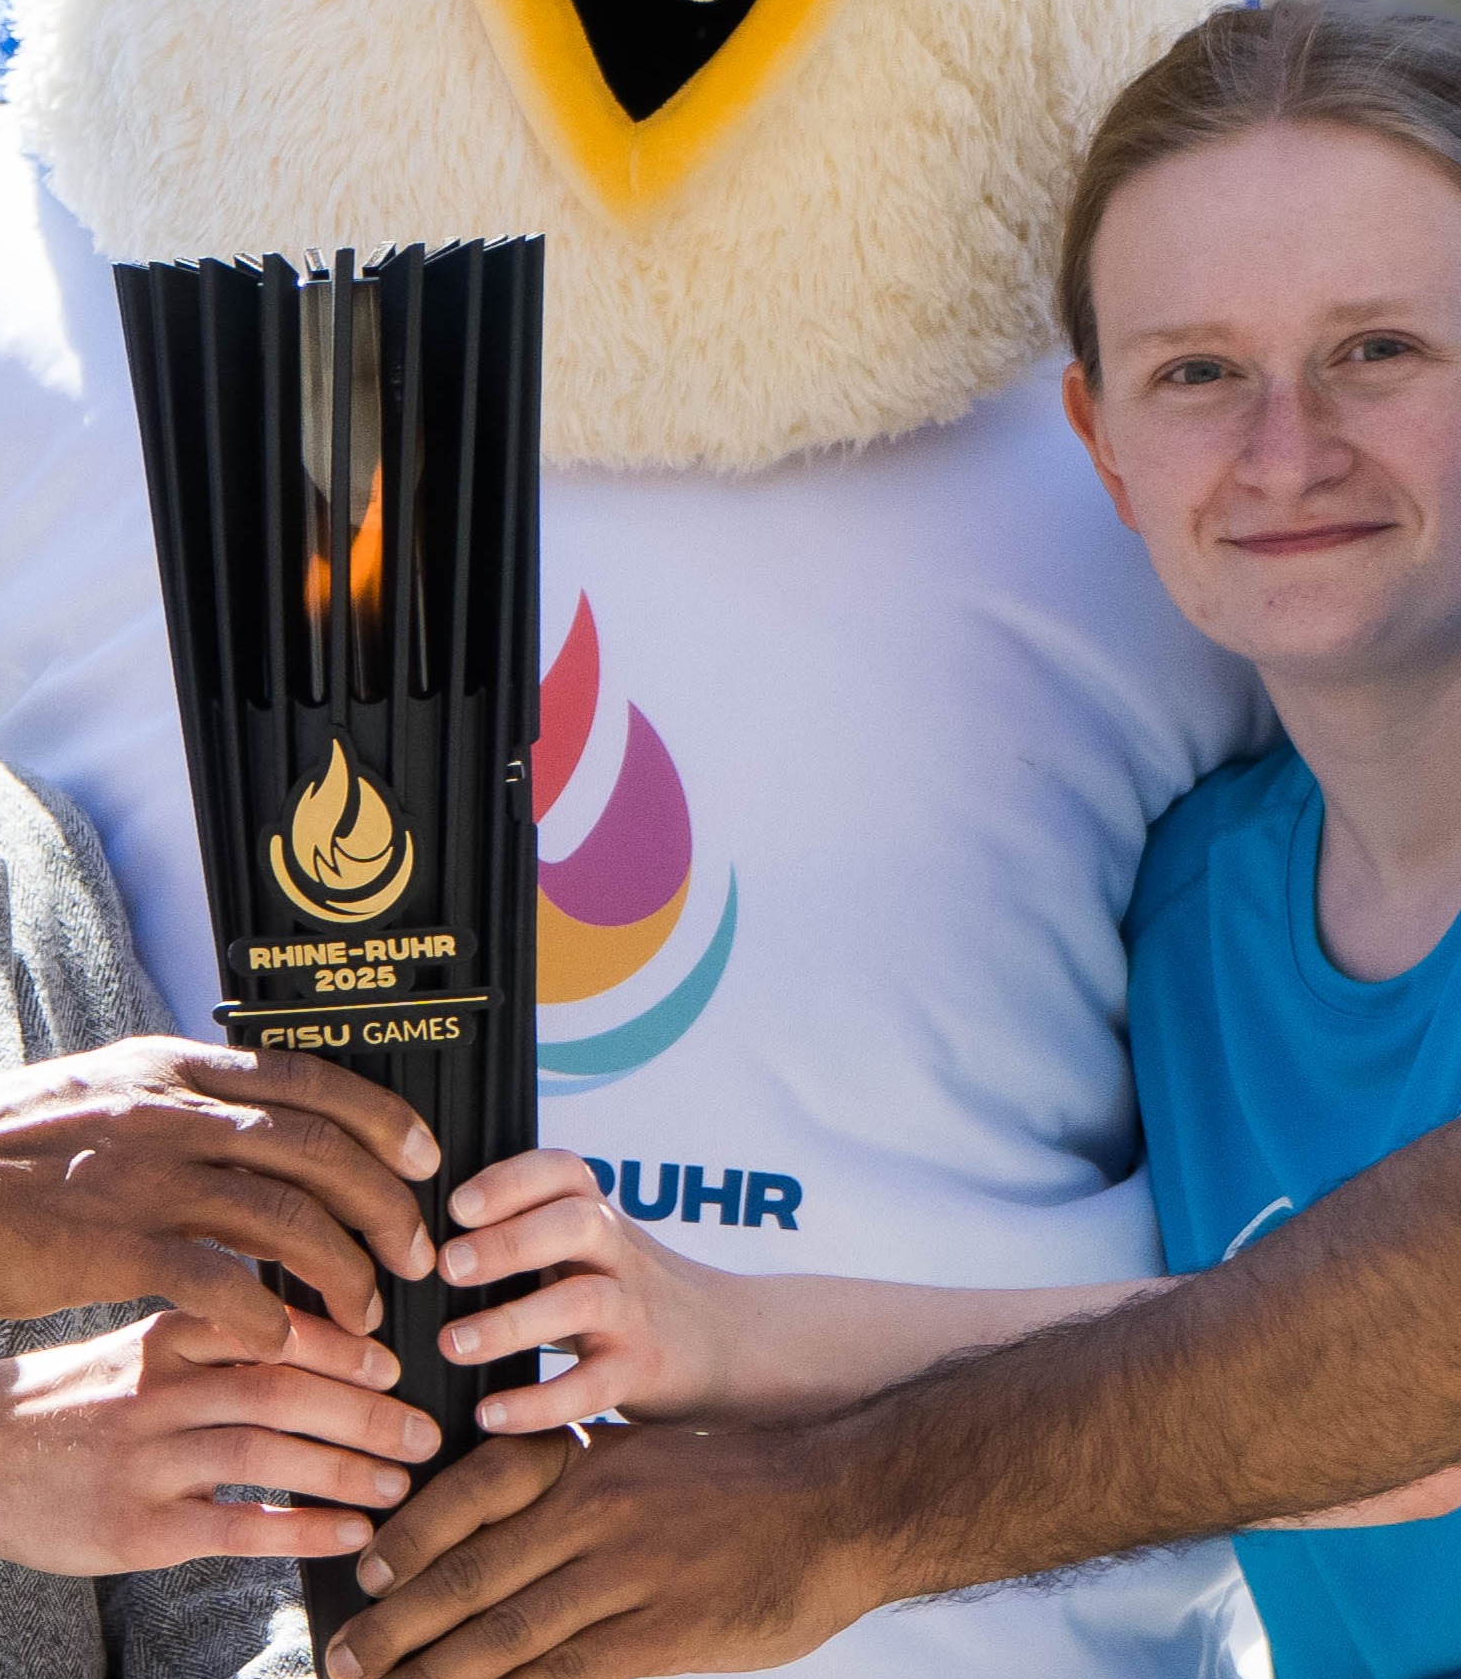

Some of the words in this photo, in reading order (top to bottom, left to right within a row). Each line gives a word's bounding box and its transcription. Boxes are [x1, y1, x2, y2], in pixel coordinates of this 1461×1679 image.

[249, 934, 456, 970] RHINE-RUHR
[314, 965, 397, 993] 2025
[362, 1015, 460, 1045] GAMES
